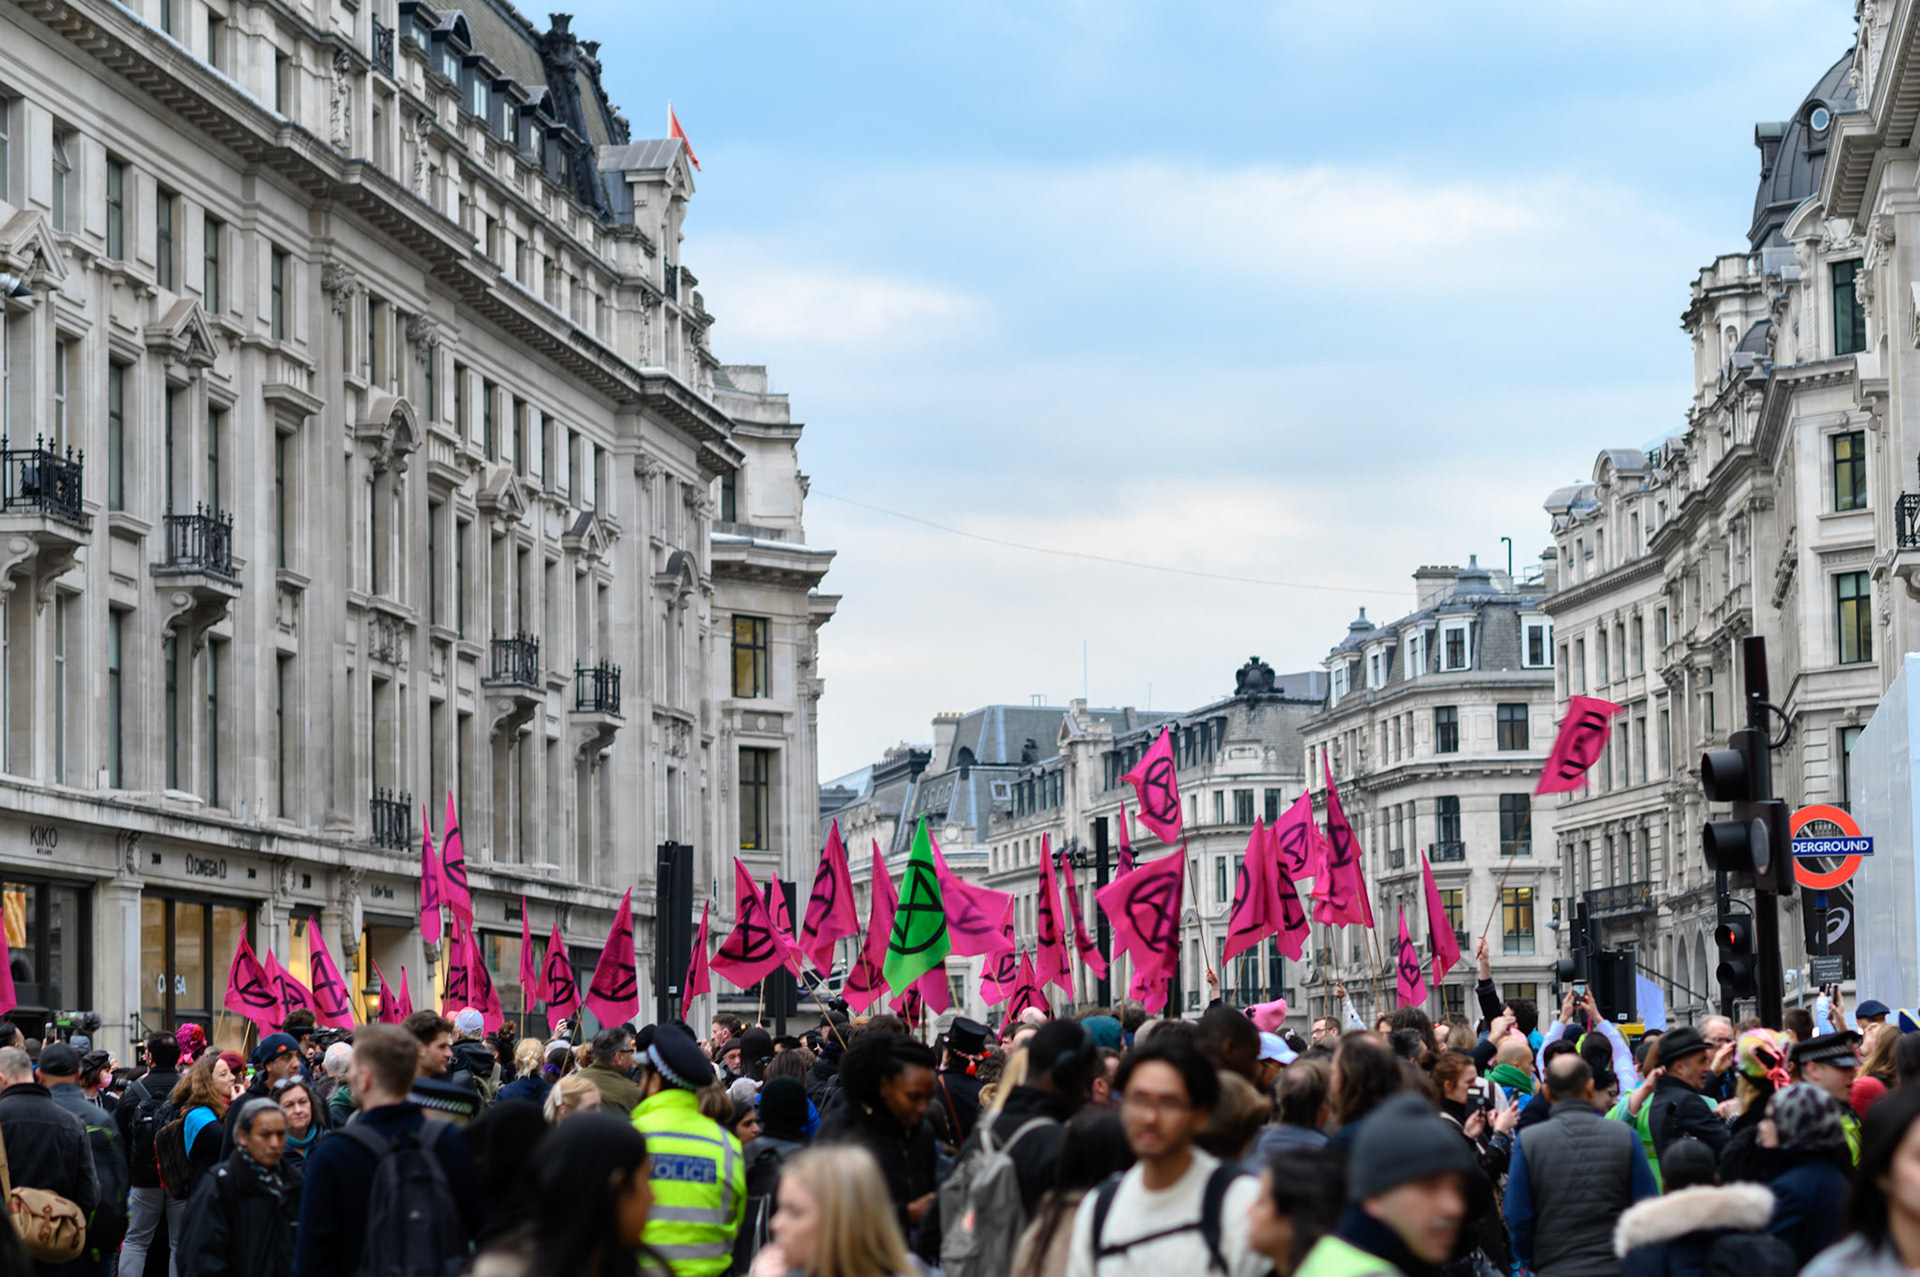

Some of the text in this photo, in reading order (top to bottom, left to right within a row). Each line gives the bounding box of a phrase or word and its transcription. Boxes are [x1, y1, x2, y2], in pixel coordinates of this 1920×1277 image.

[30, 825, 58, 848] KIKO
[1792, 840, 1870, 853] DERGROUND
[158, 973, 187, 995] OGA
[650, 1162, 716, 1183] OLICE
